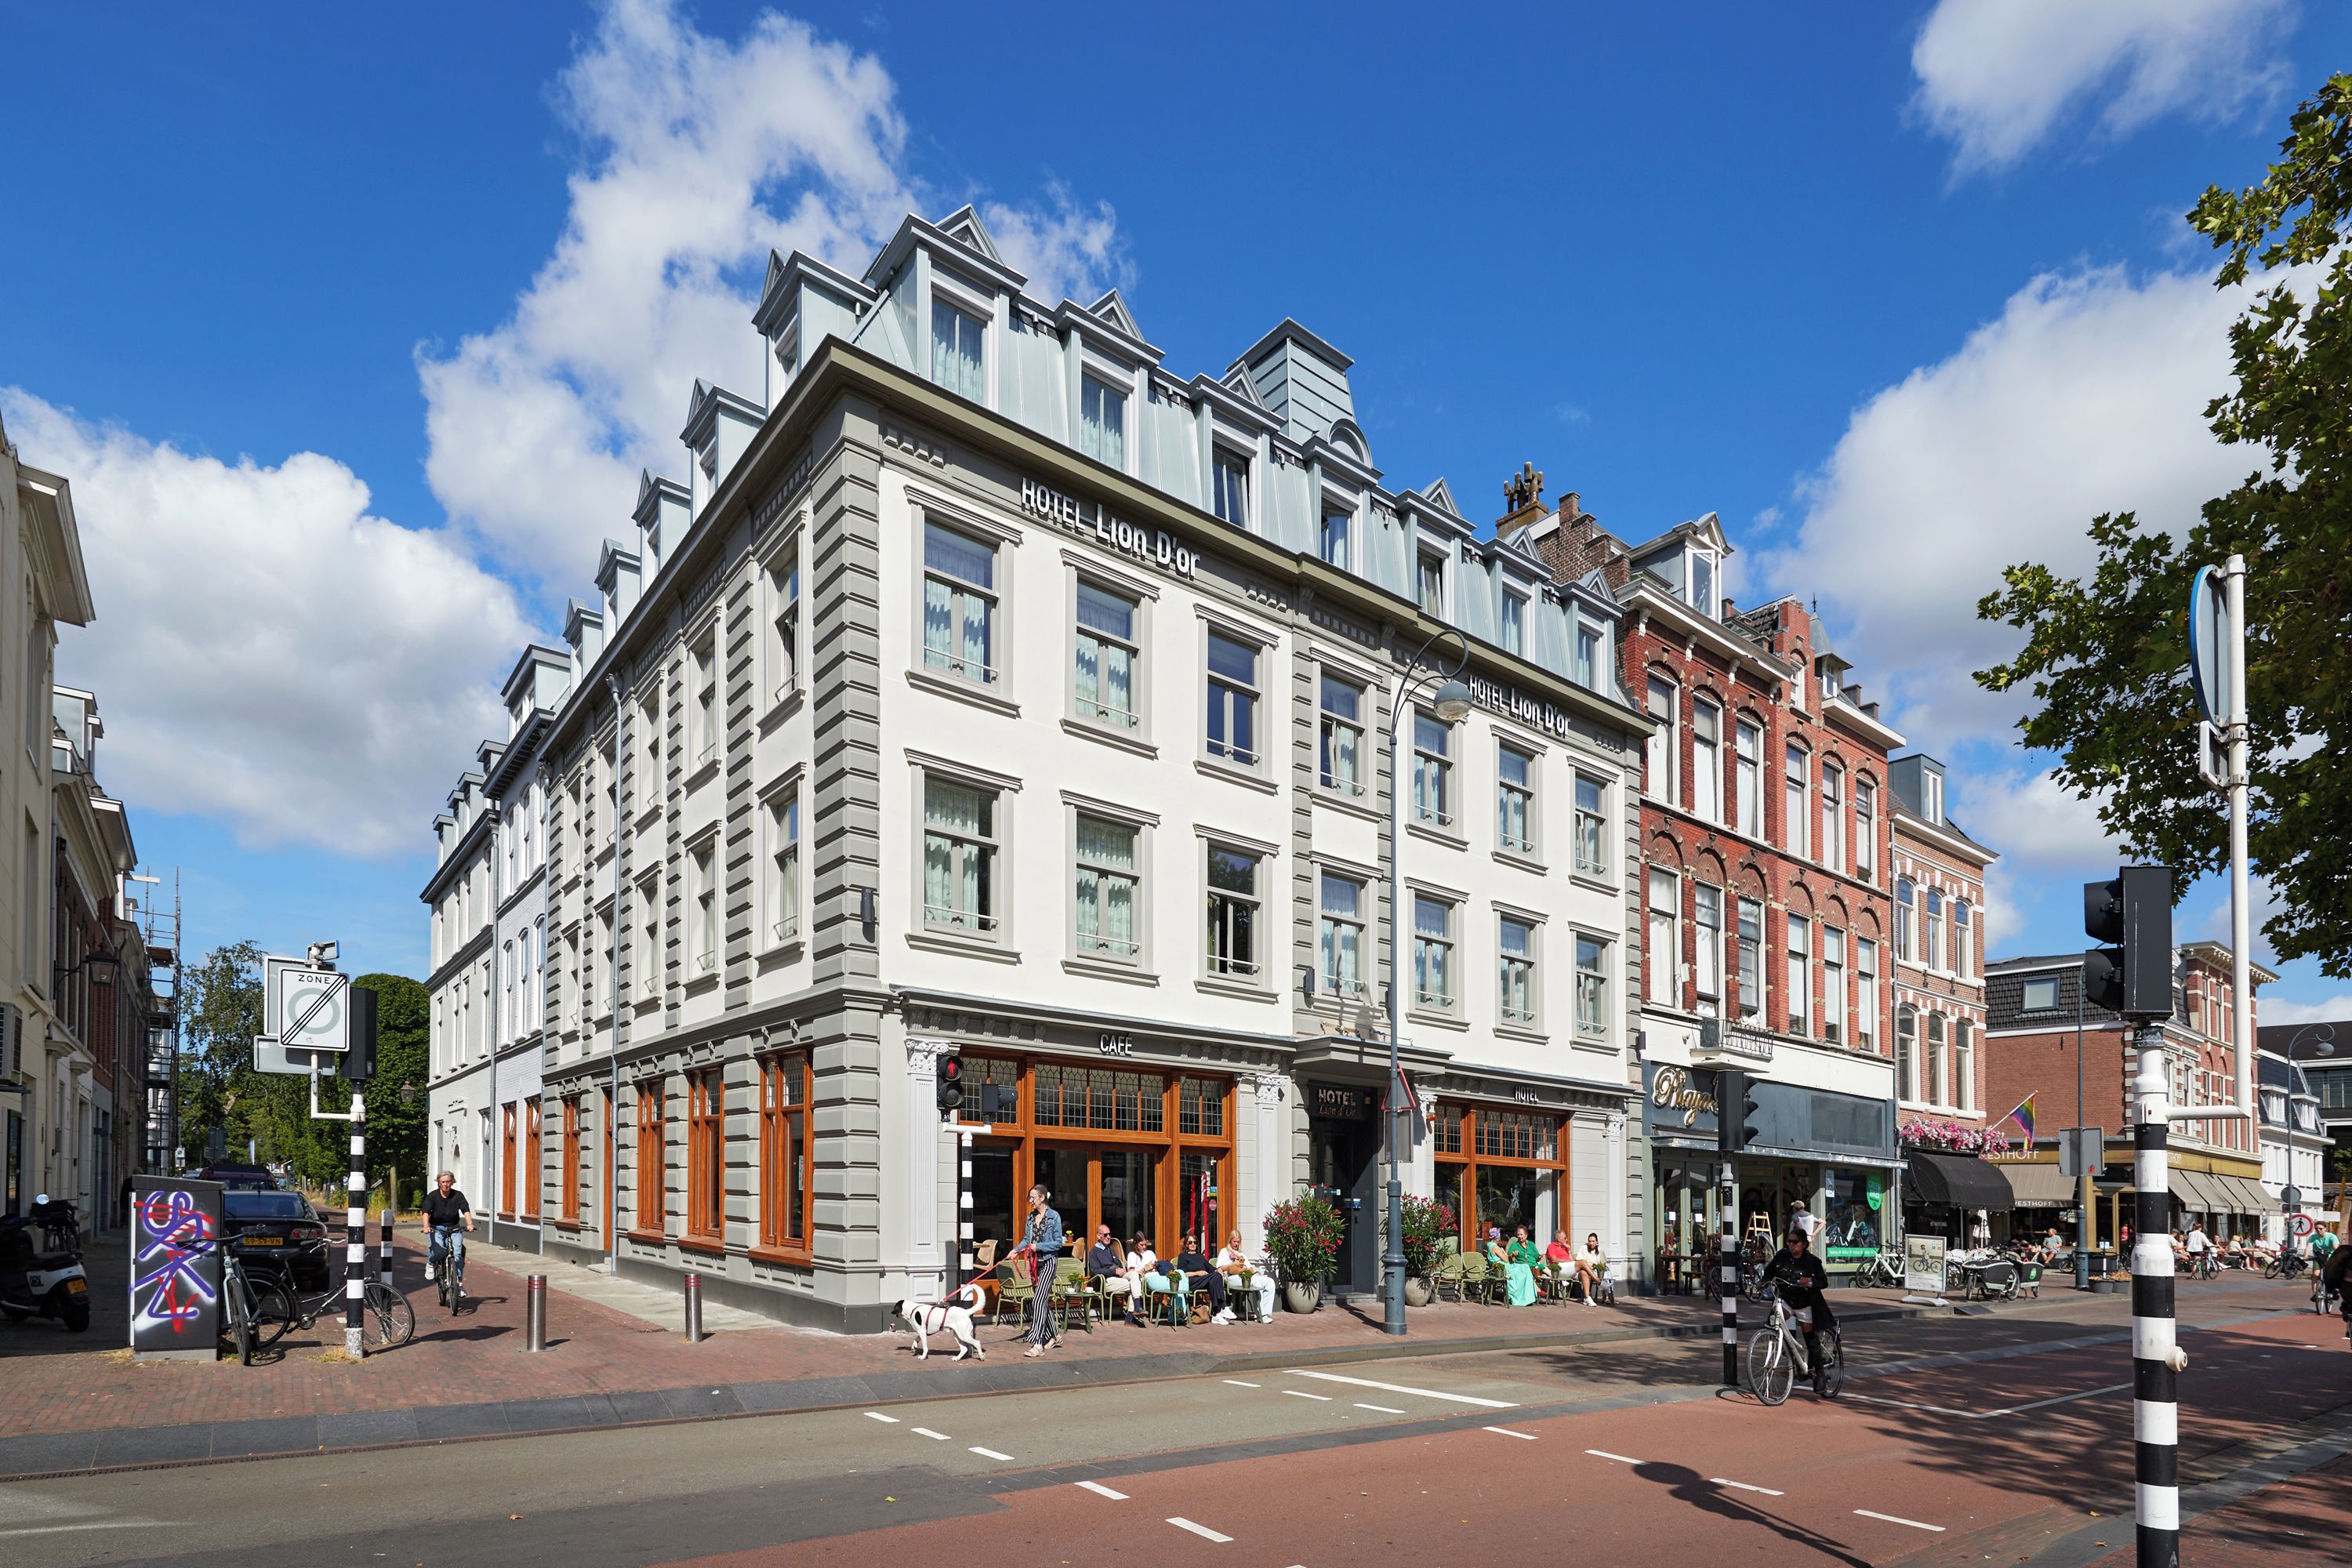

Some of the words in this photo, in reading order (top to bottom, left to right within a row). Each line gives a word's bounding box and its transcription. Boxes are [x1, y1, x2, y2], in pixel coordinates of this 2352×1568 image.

[1022, 477, 1085, 529] HOTEL
[1469, 674, 1505, 708] HOTEL
[298, 974, 330, 985] ZONE
[1319, 1088, 1356, 1106] HOTEL
[1515, 1085, 1539, 1102] HOTEL
[1987, 1149, 2040, 1160] ESTHOFF
